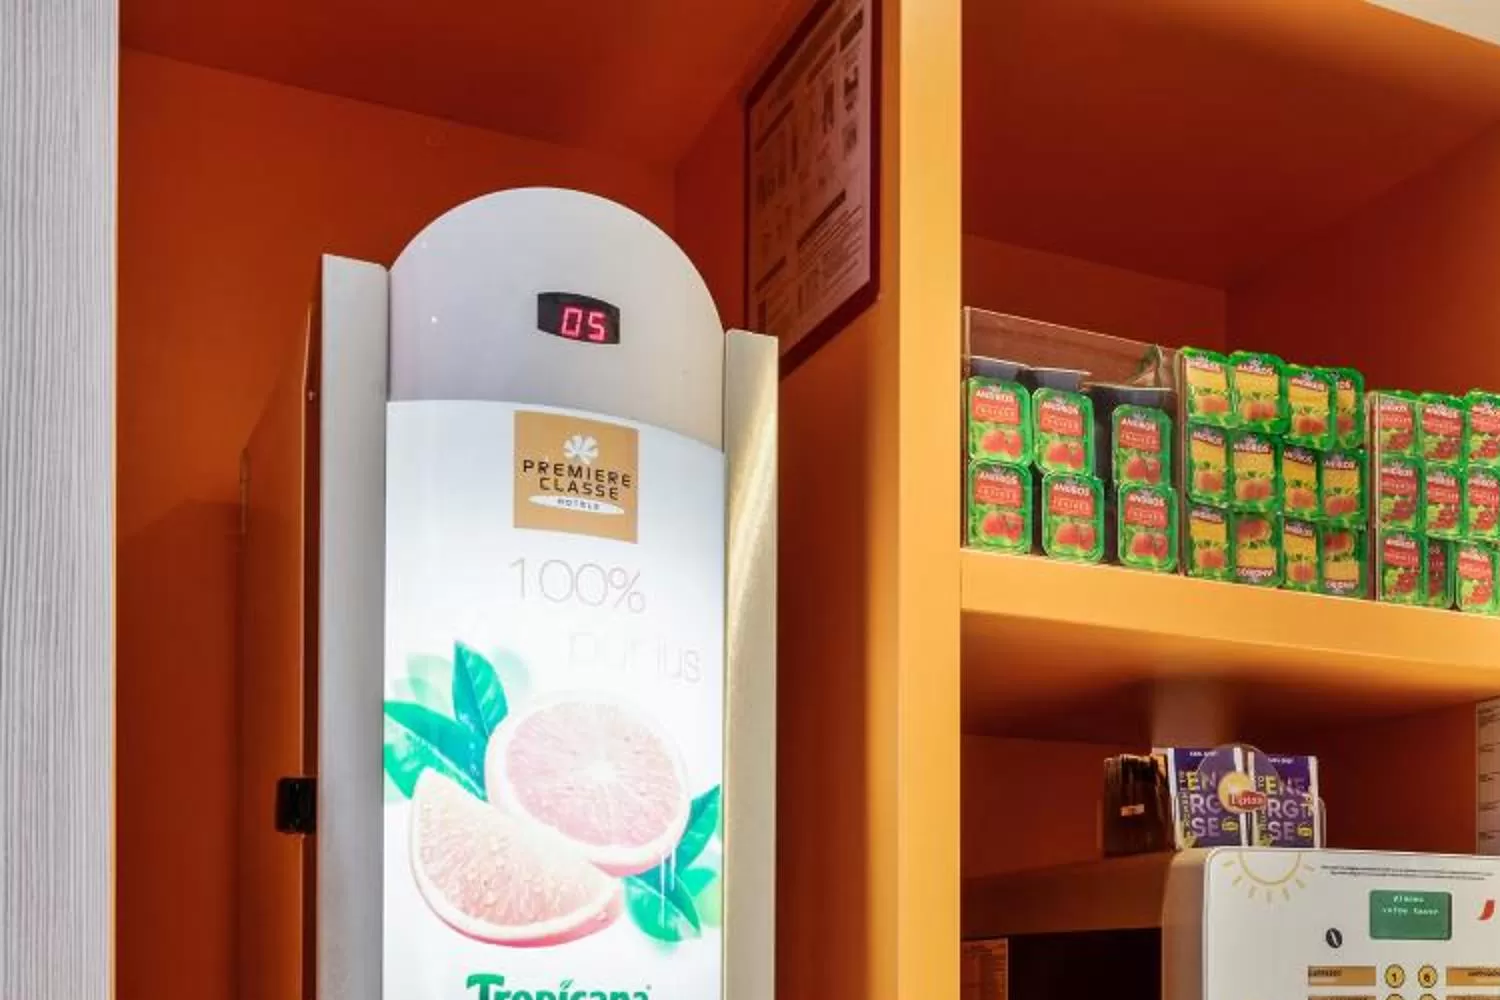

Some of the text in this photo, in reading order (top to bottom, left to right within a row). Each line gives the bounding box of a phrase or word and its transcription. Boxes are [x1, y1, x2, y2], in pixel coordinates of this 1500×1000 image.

[562, 307, 606, 341] 05
[523, 459, 632, 488] PREMIERE
[540, 477, 619, 500] CLASSE
[509, 557, 646, 613] 100%
